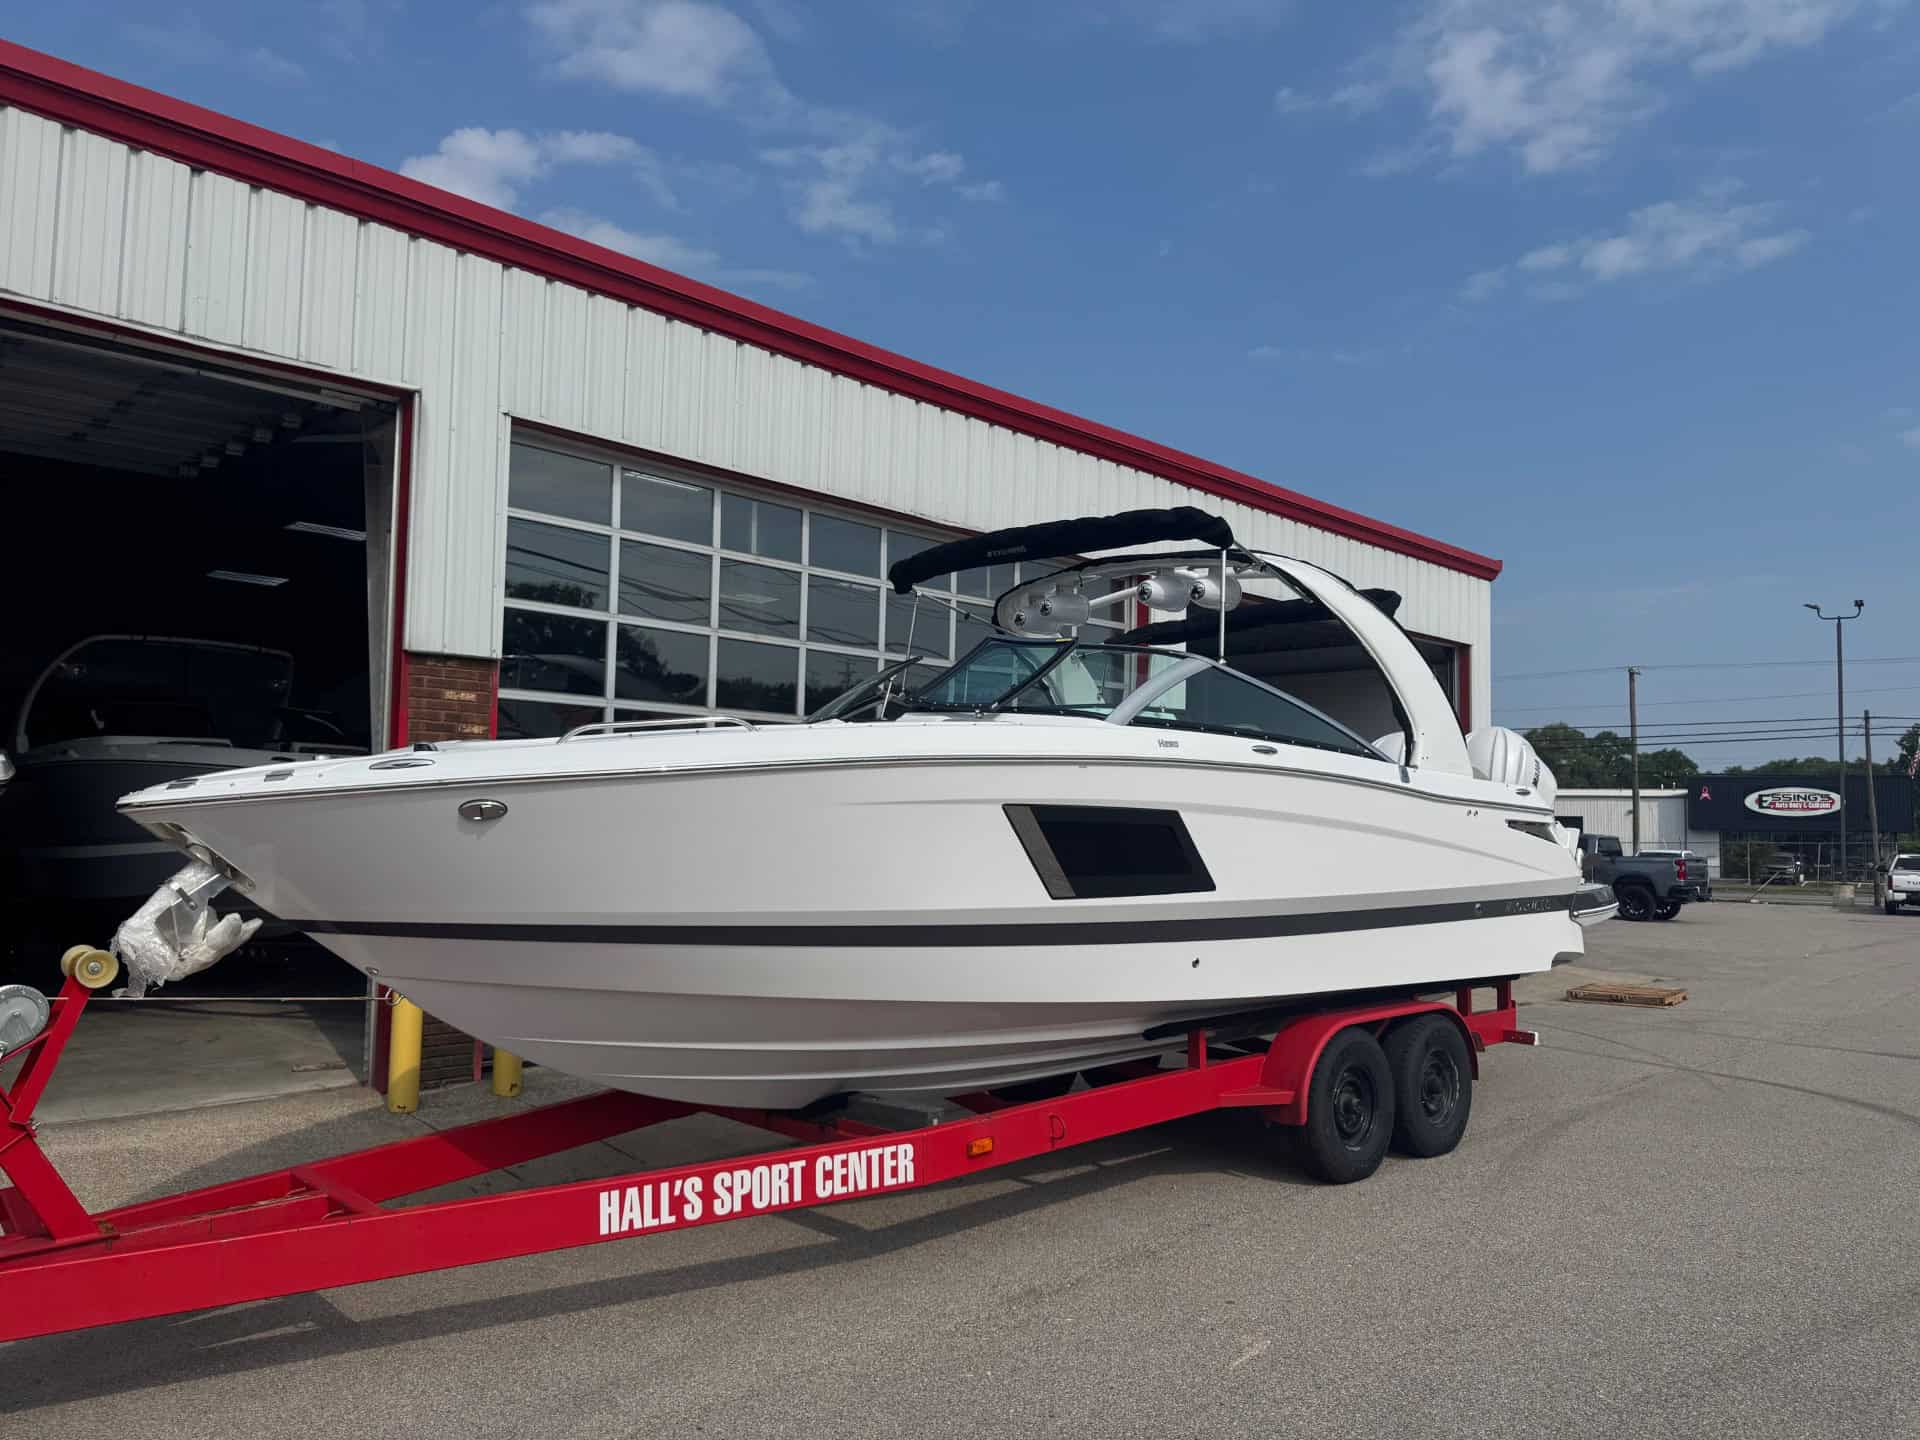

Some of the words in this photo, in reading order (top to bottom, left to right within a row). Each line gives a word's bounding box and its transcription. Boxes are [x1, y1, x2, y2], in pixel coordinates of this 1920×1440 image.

[599, 1176, 703, 1236] HALL'S
[713, 1160, 806, 1216] SPORT
[815, 1143, 914, 1199] CENTER
